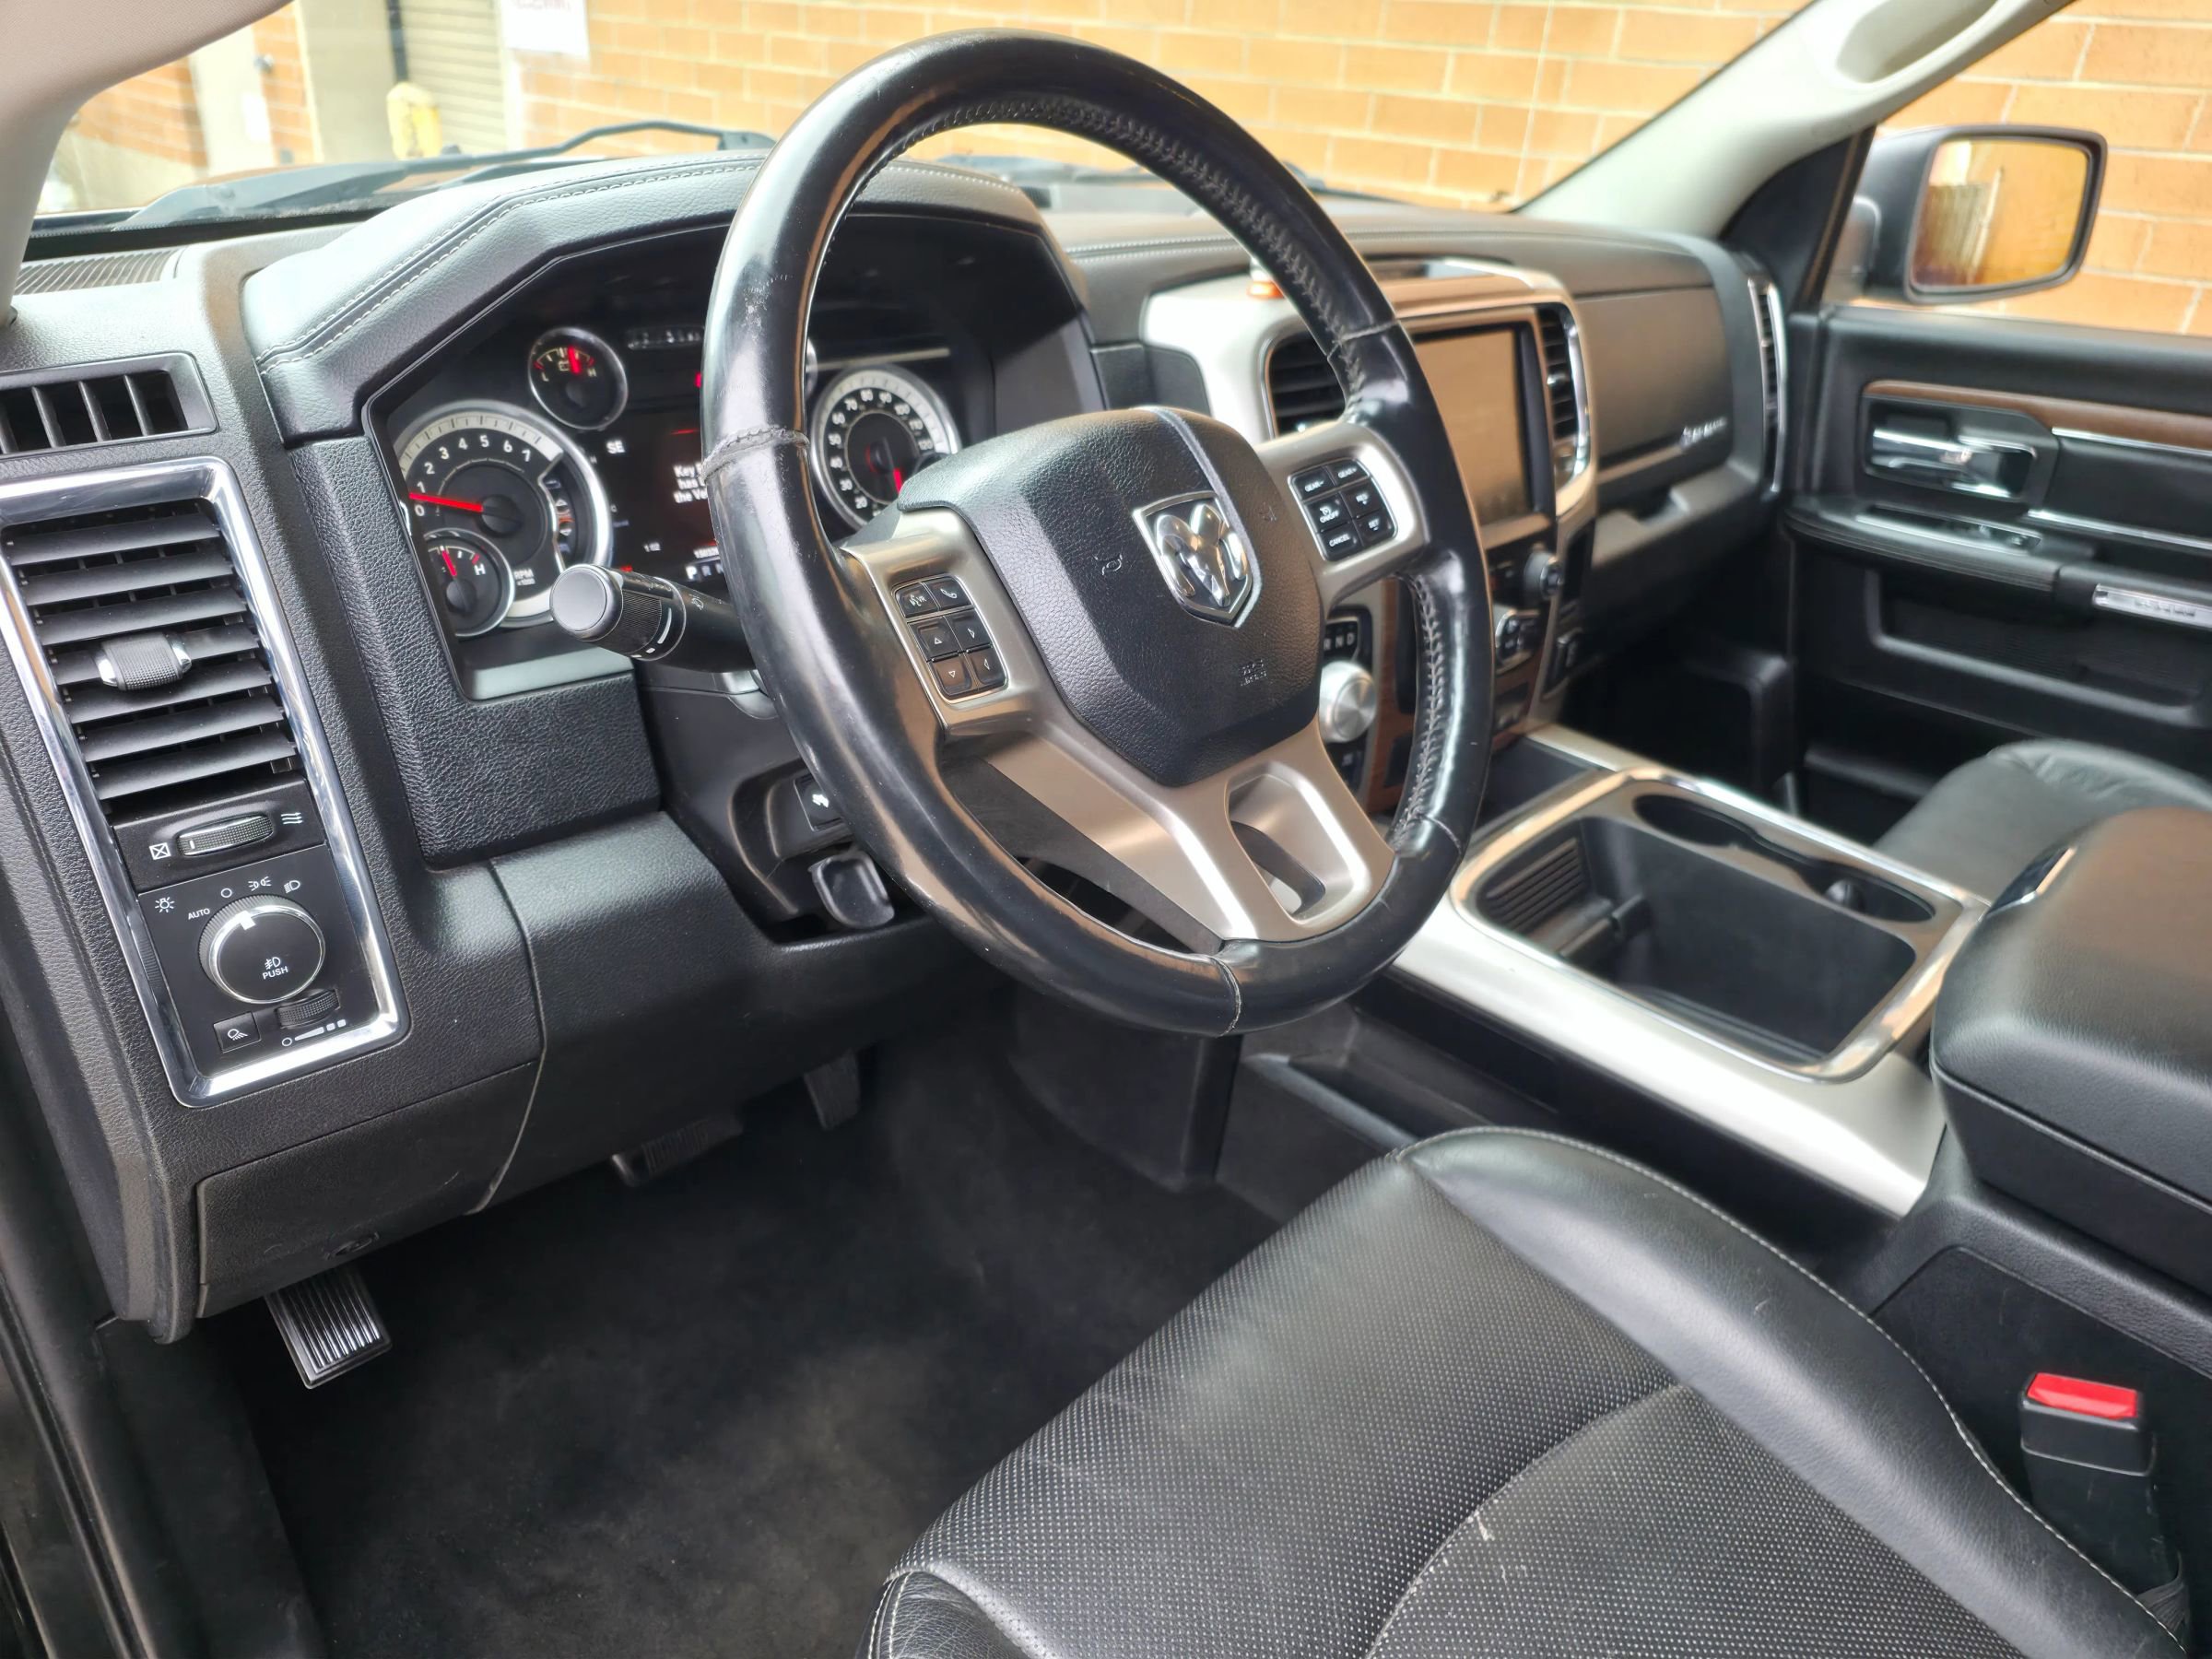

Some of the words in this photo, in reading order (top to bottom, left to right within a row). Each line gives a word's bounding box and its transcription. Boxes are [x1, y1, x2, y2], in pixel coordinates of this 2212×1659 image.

[541, 371, 549, 382] L
[458, 437, 468, 450] 4
[479, 434, 490, 448] 5
[503, 439, 513, 453] 6
[606, 440, 625, 454] SE
[439, 446, 450, 460] 3
[522, 449, 532, 462] 7
[424, 462, 435, 475] 2
[674, 464, 695, 478] Key
[417, 481, 426, 493] 1
[677, 477, 699, 489] has
[674, 490, 693, 503] the
[414, 504, 425, 516] 0
[1328, 533, 1351, 547] CANCEL
[474, 563, 486, 576] H
[686, 565, 698, 580] P
[1335, 635, 1344, 648] N
[1347, 631, 1356, 646] D
[187, 908, 211, 920] AUTO
[262, 966, 288, 980] PUSH
